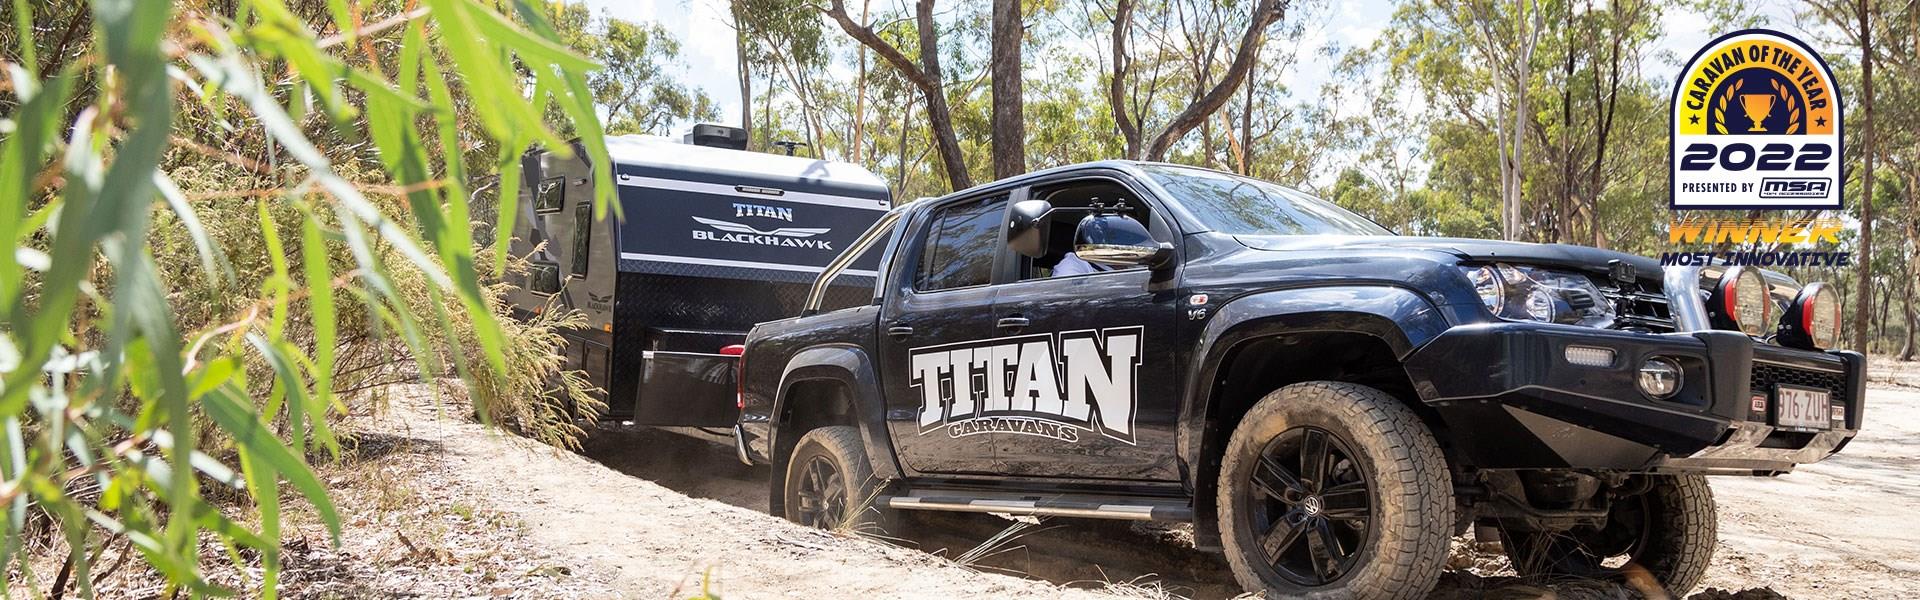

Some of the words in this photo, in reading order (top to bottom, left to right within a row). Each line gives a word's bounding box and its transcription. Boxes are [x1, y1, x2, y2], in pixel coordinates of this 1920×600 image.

[733, 203, 793, 222] TITAN
[692, 230, 833, 250] BLACKHAWK
[1188, 308, 1206, 320] V6
[910, 329, 1141, 440] TITAN
[948, 418, 1078, 442] CARAVANS
